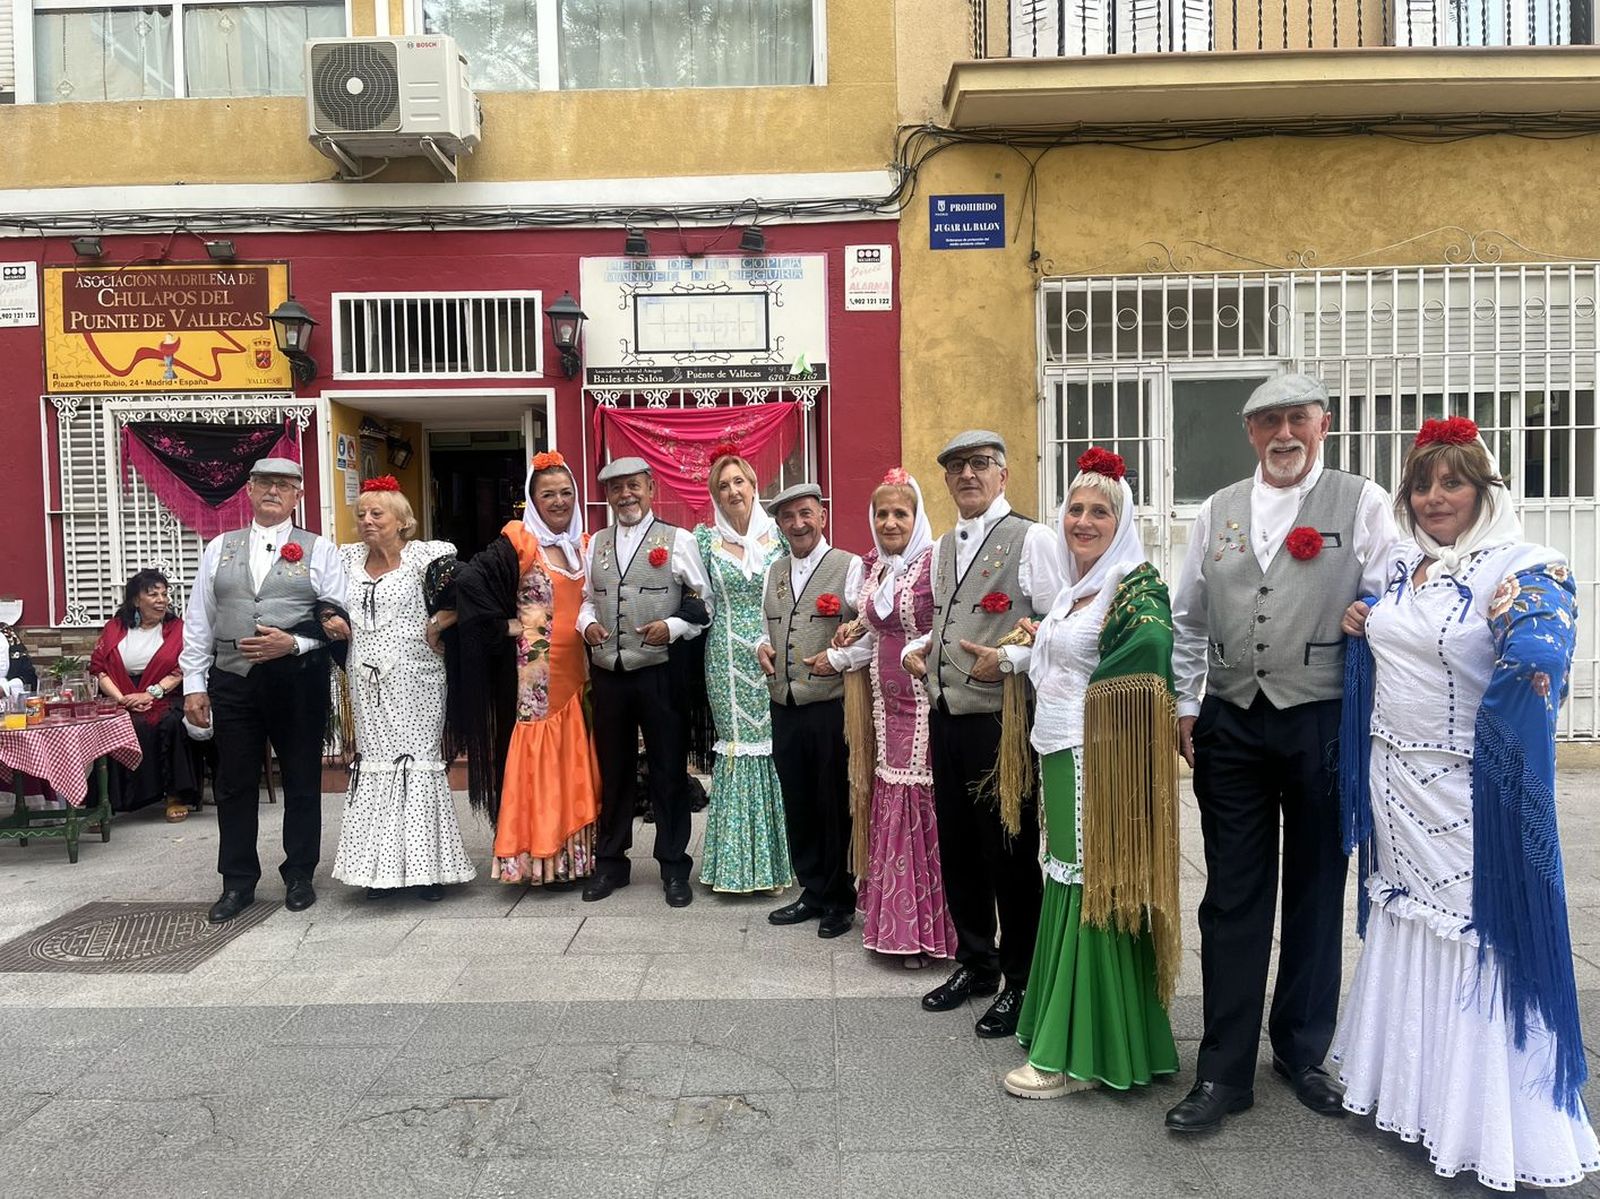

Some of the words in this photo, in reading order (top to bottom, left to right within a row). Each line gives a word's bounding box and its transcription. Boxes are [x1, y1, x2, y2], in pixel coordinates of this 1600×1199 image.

[950, 203, 997, 212] PROHIBIDO
[934, 223, 961, 232] JUGAR
[962, 223, 973, 232] AL
[973, 222, 1000, 231] BALON
[668, 260, 693, 270] DE
[75, 272, 156, 288] ASOCIACIÓN
[160, 271, 236, 286] MADRILEÑA
[239, 273, 256, 285] DE
[97, 288, 197, 307] CHULAPOS
[201, 290, 234, 305] DEL
[70, 311, 139, 330] PUENTE
[143, 313, 165, 328] DE
[169, 309, 264, 328] VALLECAS
[593, 374, 621, 383] Bailes
[624, 374, 634, 383] de
[637, 373, 664, 383] Salón
[687, 370, 714, 379] Puente
[716, 370, 727, 378] de
[729, 369, 761, 378] Vallecas
[53, 380, 74, 388] Plaza
[76, 380, 101, 388] Puerto
[103, 380, 128, 388] Rubio,
[145, 378, 172, 387] Madrid
[179, 378, 208, 387] España
